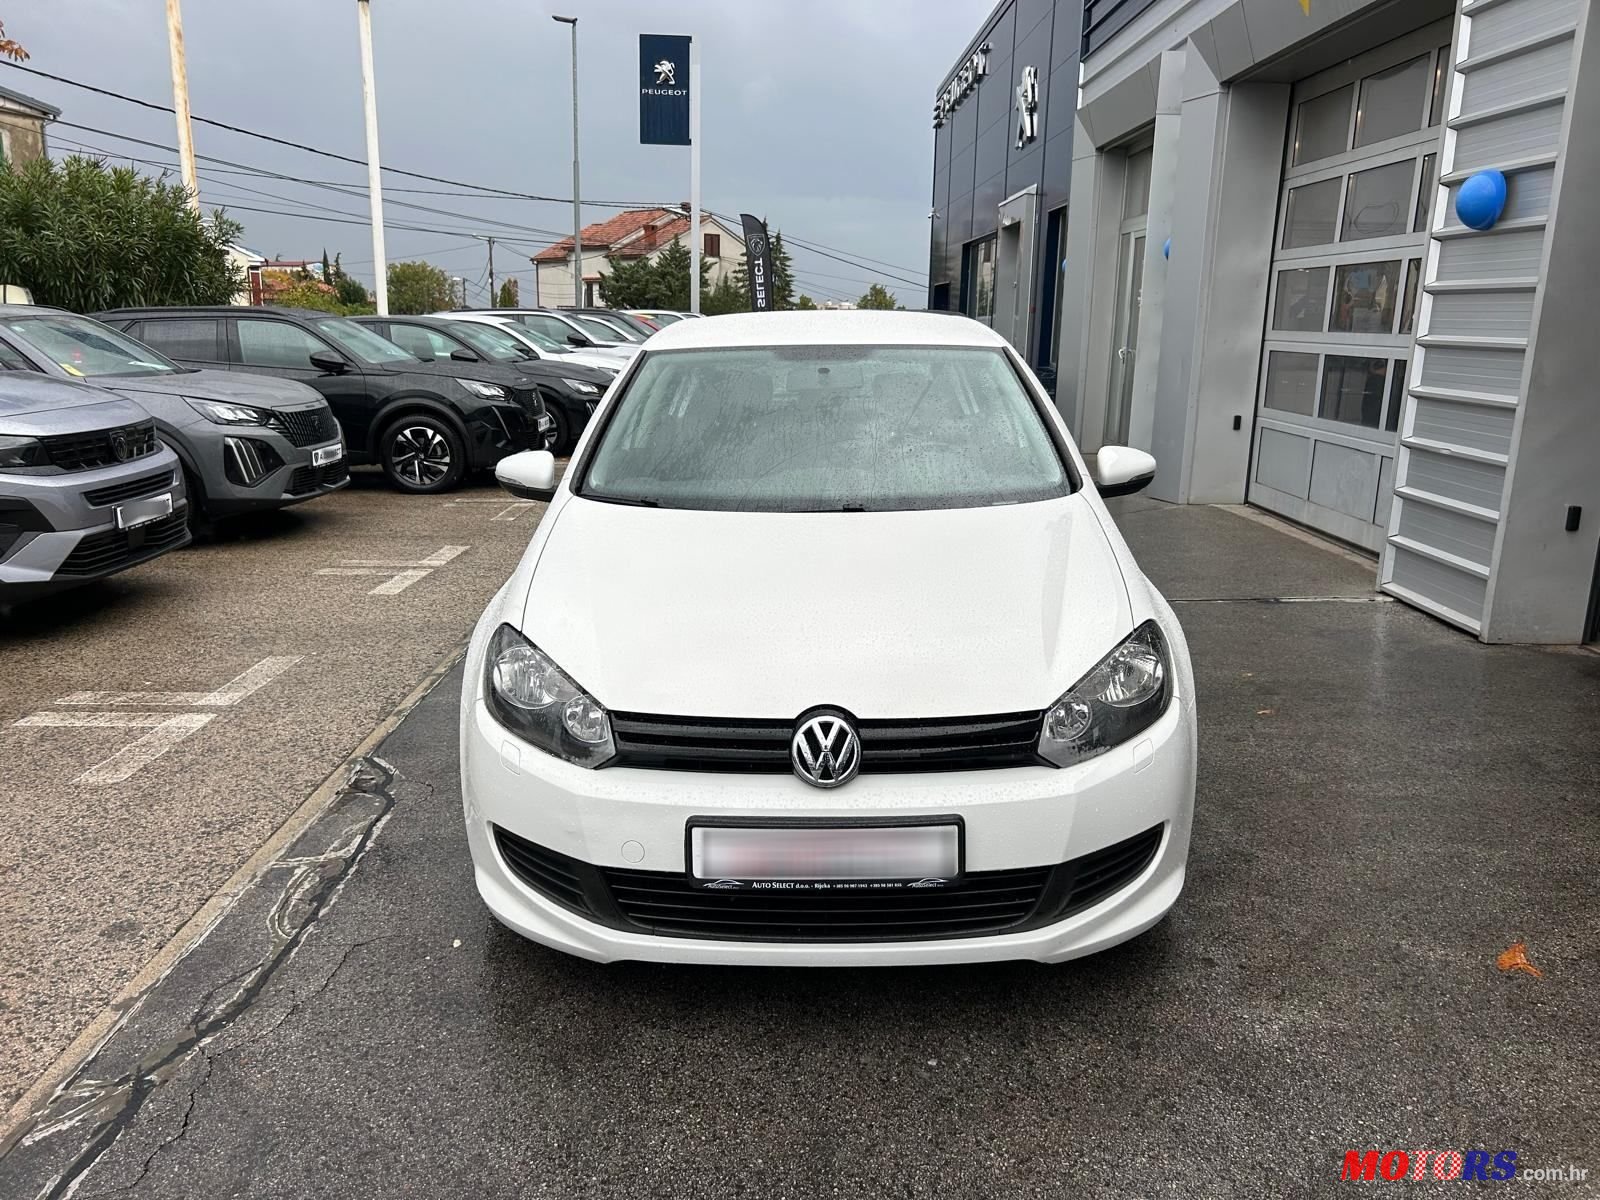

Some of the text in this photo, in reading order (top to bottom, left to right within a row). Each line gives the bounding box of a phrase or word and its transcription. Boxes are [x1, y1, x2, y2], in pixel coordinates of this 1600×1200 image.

[641, 88, 688, 96] PEUGEOT
[752, 881, 772, 889] AUTO
[772, 881, 795, 889] SELECT
